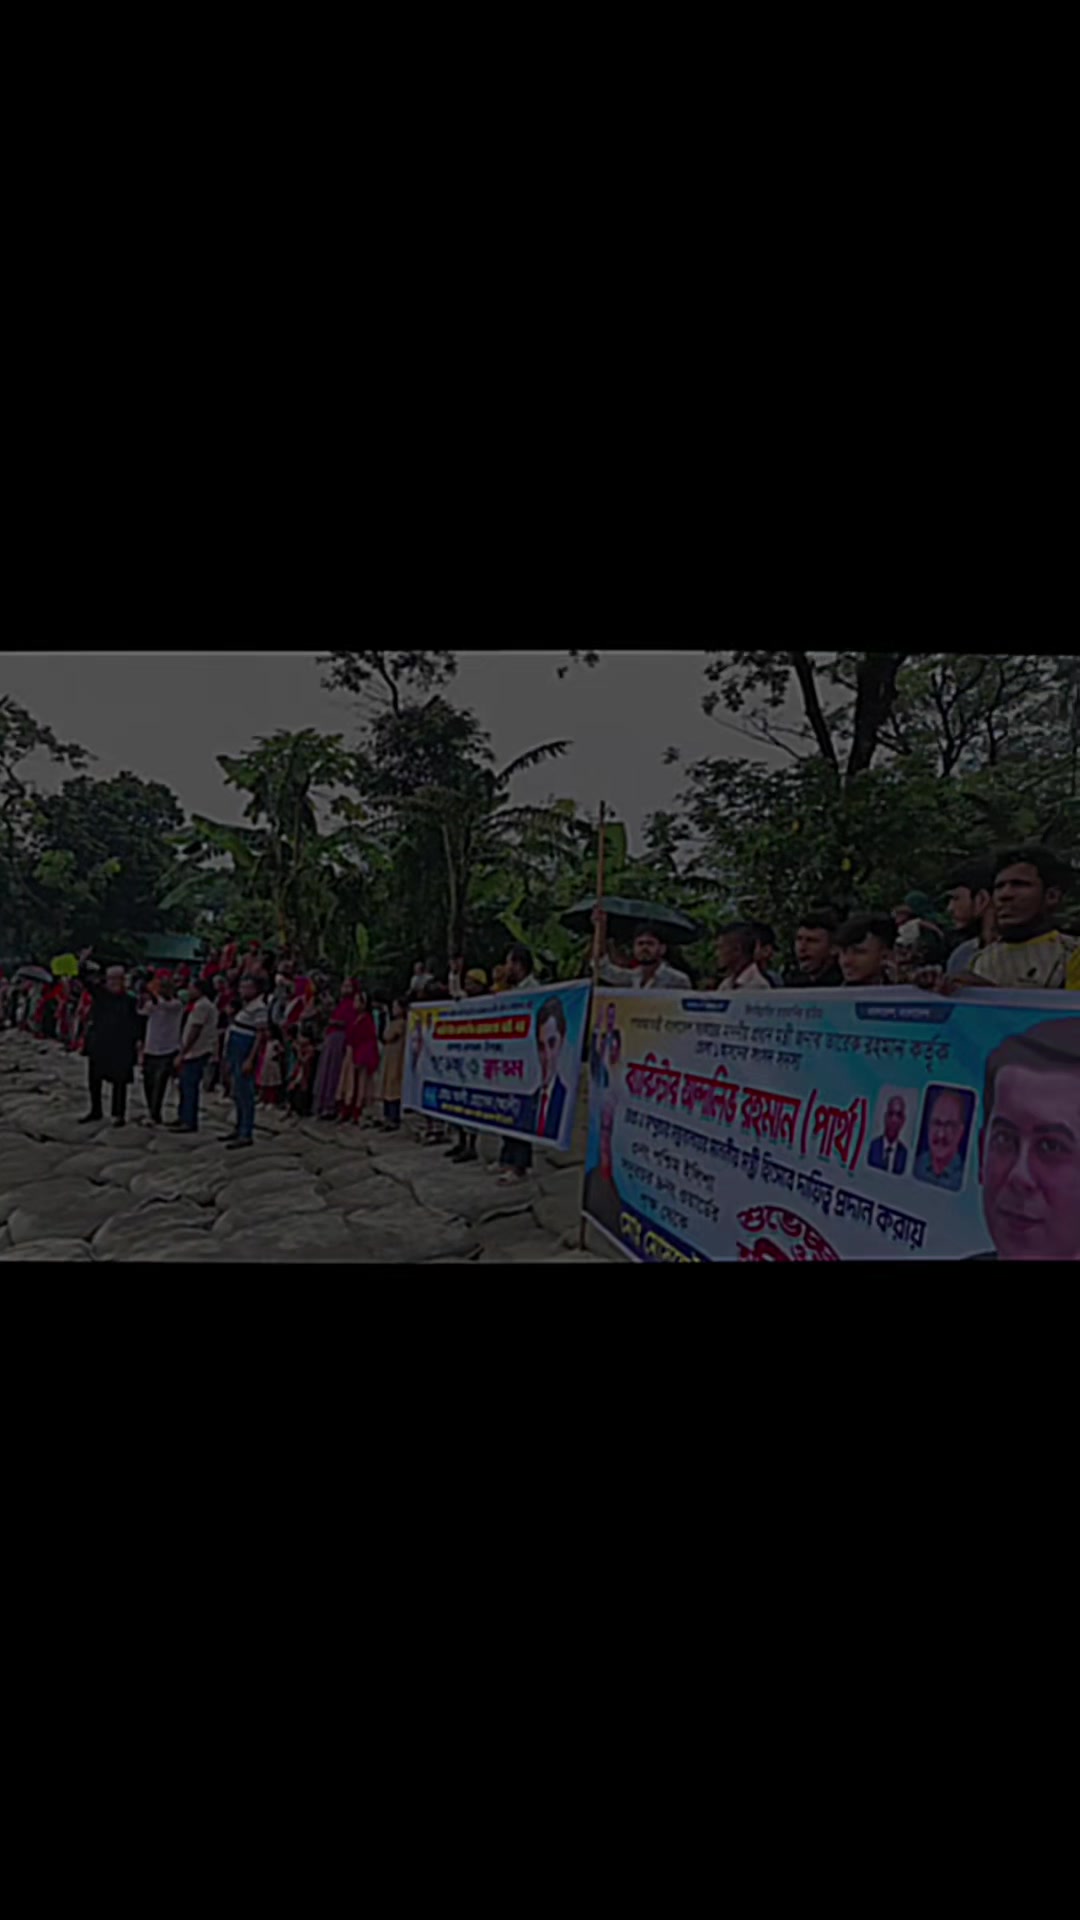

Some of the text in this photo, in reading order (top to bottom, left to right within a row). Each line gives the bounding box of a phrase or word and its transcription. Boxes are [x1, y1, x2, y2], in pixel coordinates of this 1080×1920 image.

[864, 1034, 904, 1058] রহমান
[741, 1086, 802, 1148] রহমান
[834, 1188, 875, 1226] প্রদান
[875, 1204, 927, 1250] করায়
